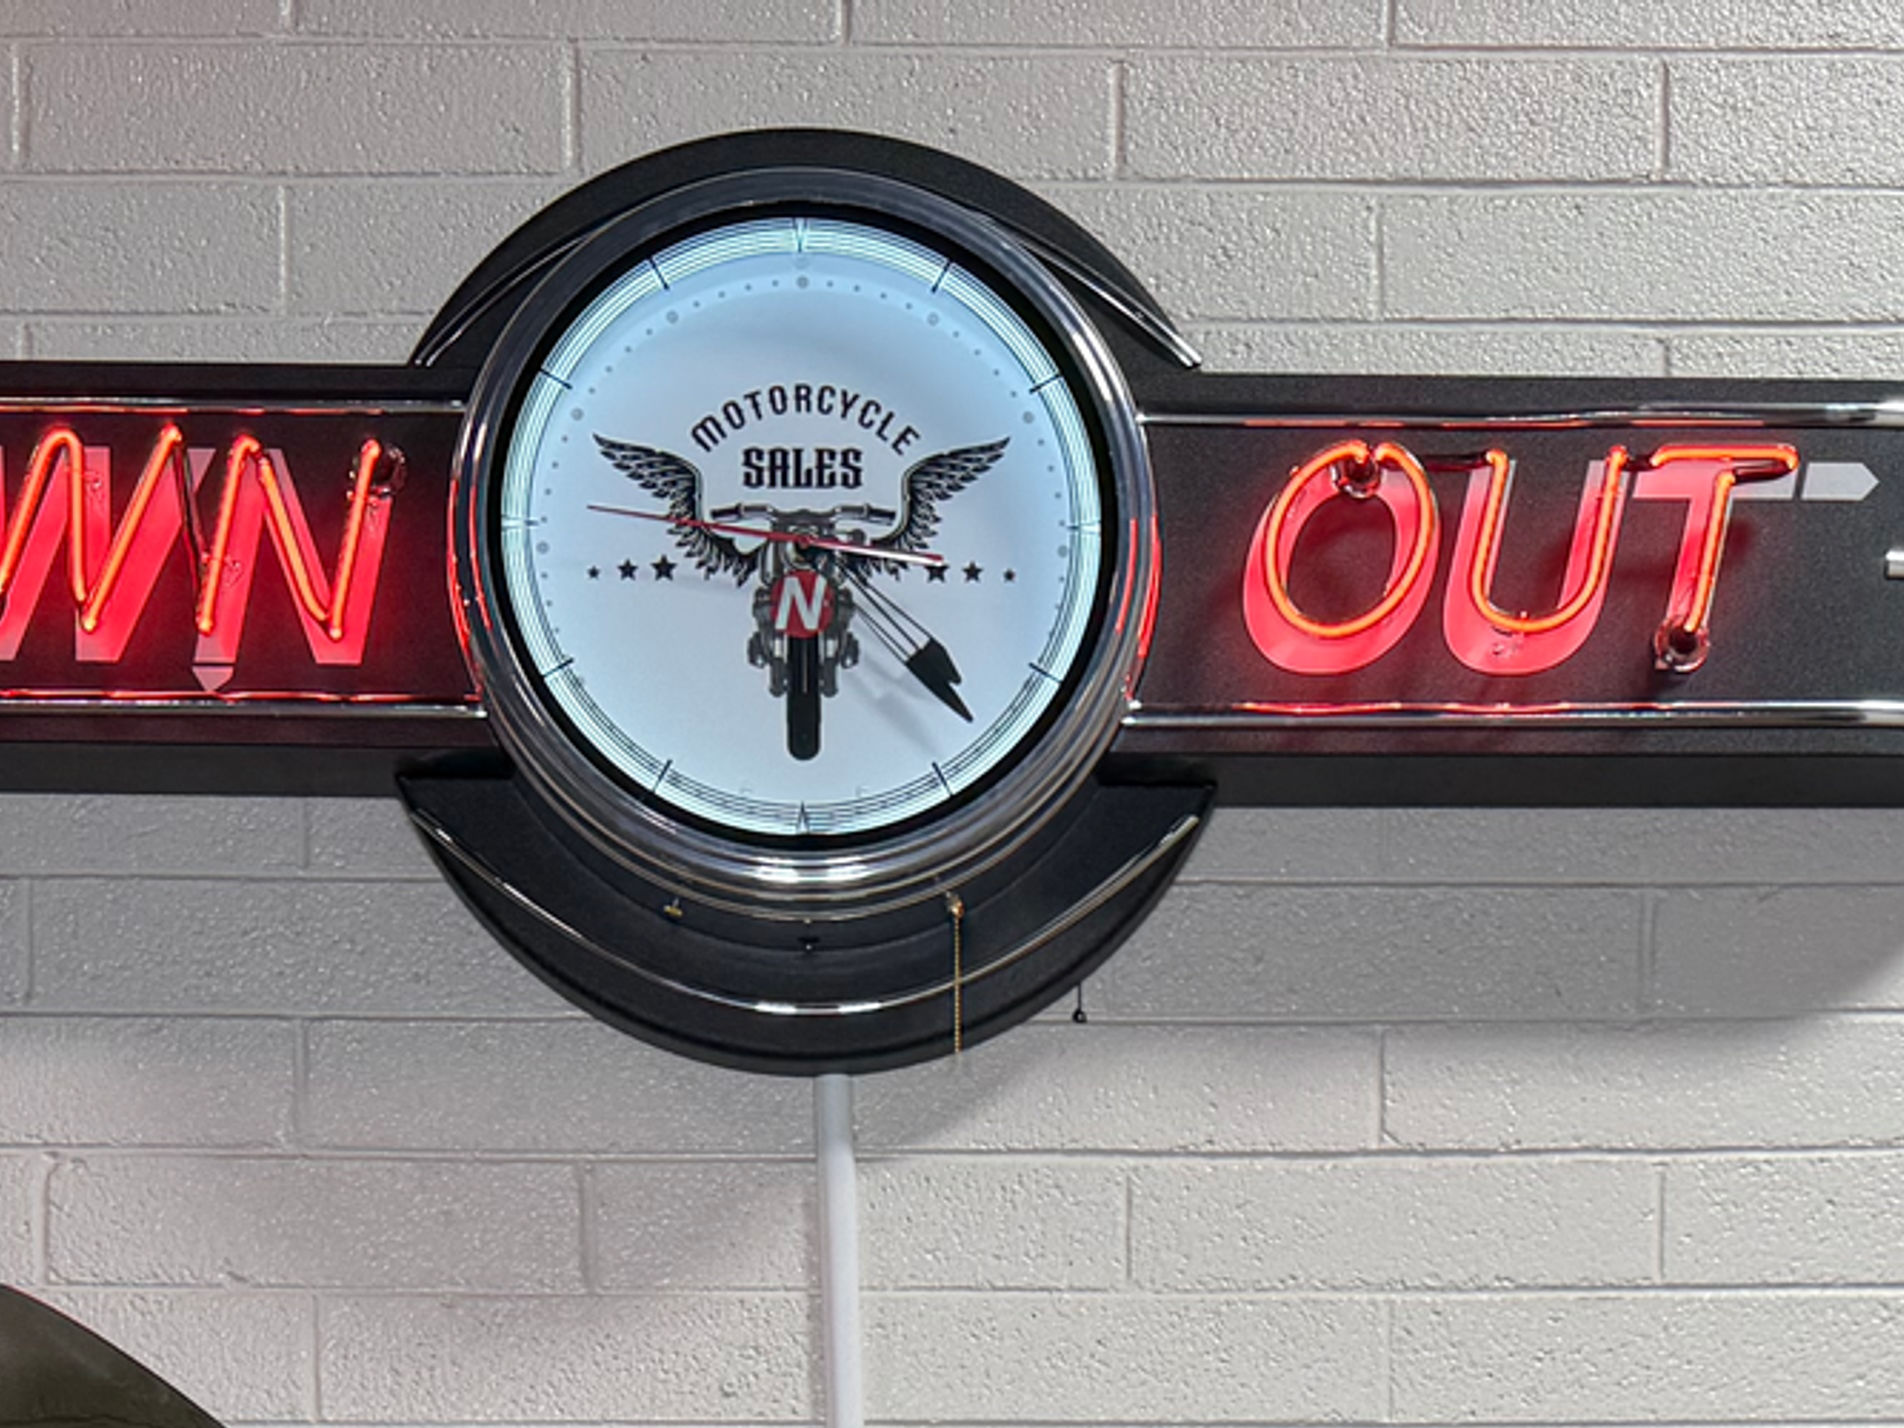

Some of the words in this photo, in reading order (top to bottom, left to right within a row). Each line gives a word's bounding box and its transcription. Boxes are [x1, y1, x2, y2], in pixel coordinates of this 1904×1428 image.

[691, 383, 921, 455] MOTORCYCLE
[742, 446, 863, 489] SALES
[1243, 441, 1799, 674] OUT
[775, 575, 827, 630] N
